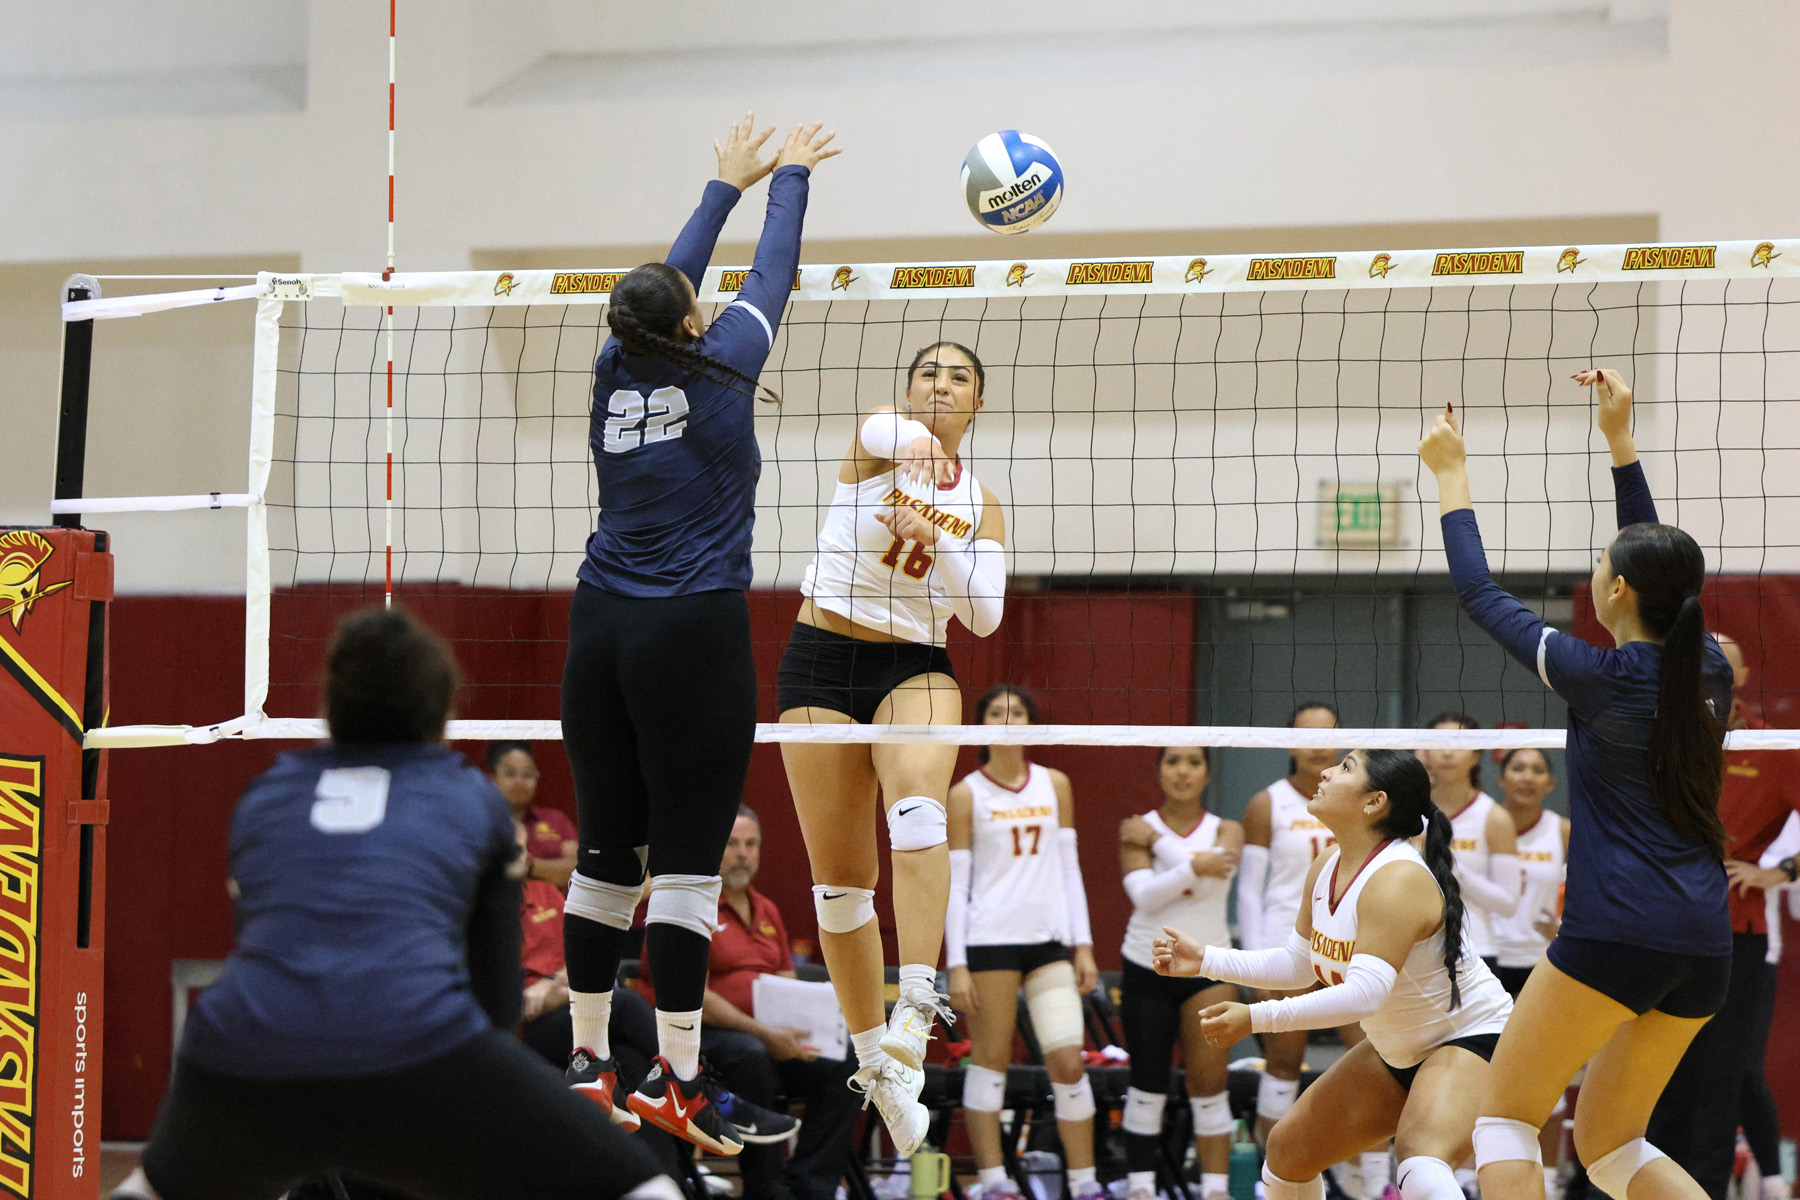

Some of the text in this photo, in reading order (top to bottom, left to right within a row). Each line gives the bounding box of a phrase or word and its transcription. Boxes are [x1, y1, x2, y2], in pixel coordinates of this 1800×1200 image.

[987, 173, 1042, 209] molten
[1001, 191, 1046, 224] NCAA
[1246, 256, 1337, 281] PASADENA
[1431, 251, 1525, 276] PASADENA
[1621, 246, 1717, 270] PASADENA
[550, 272, 629, 294] PASADEN
[890, 265, 976, 289] PASADENA
[1065, 261, 1154, 285] PASADENA
[603, 385, 690, 454] 22
[880, 534, 934, 581] 16
[1010, 823, 1043, 857] 17
[71, 992, 88, 1178] sports imports
